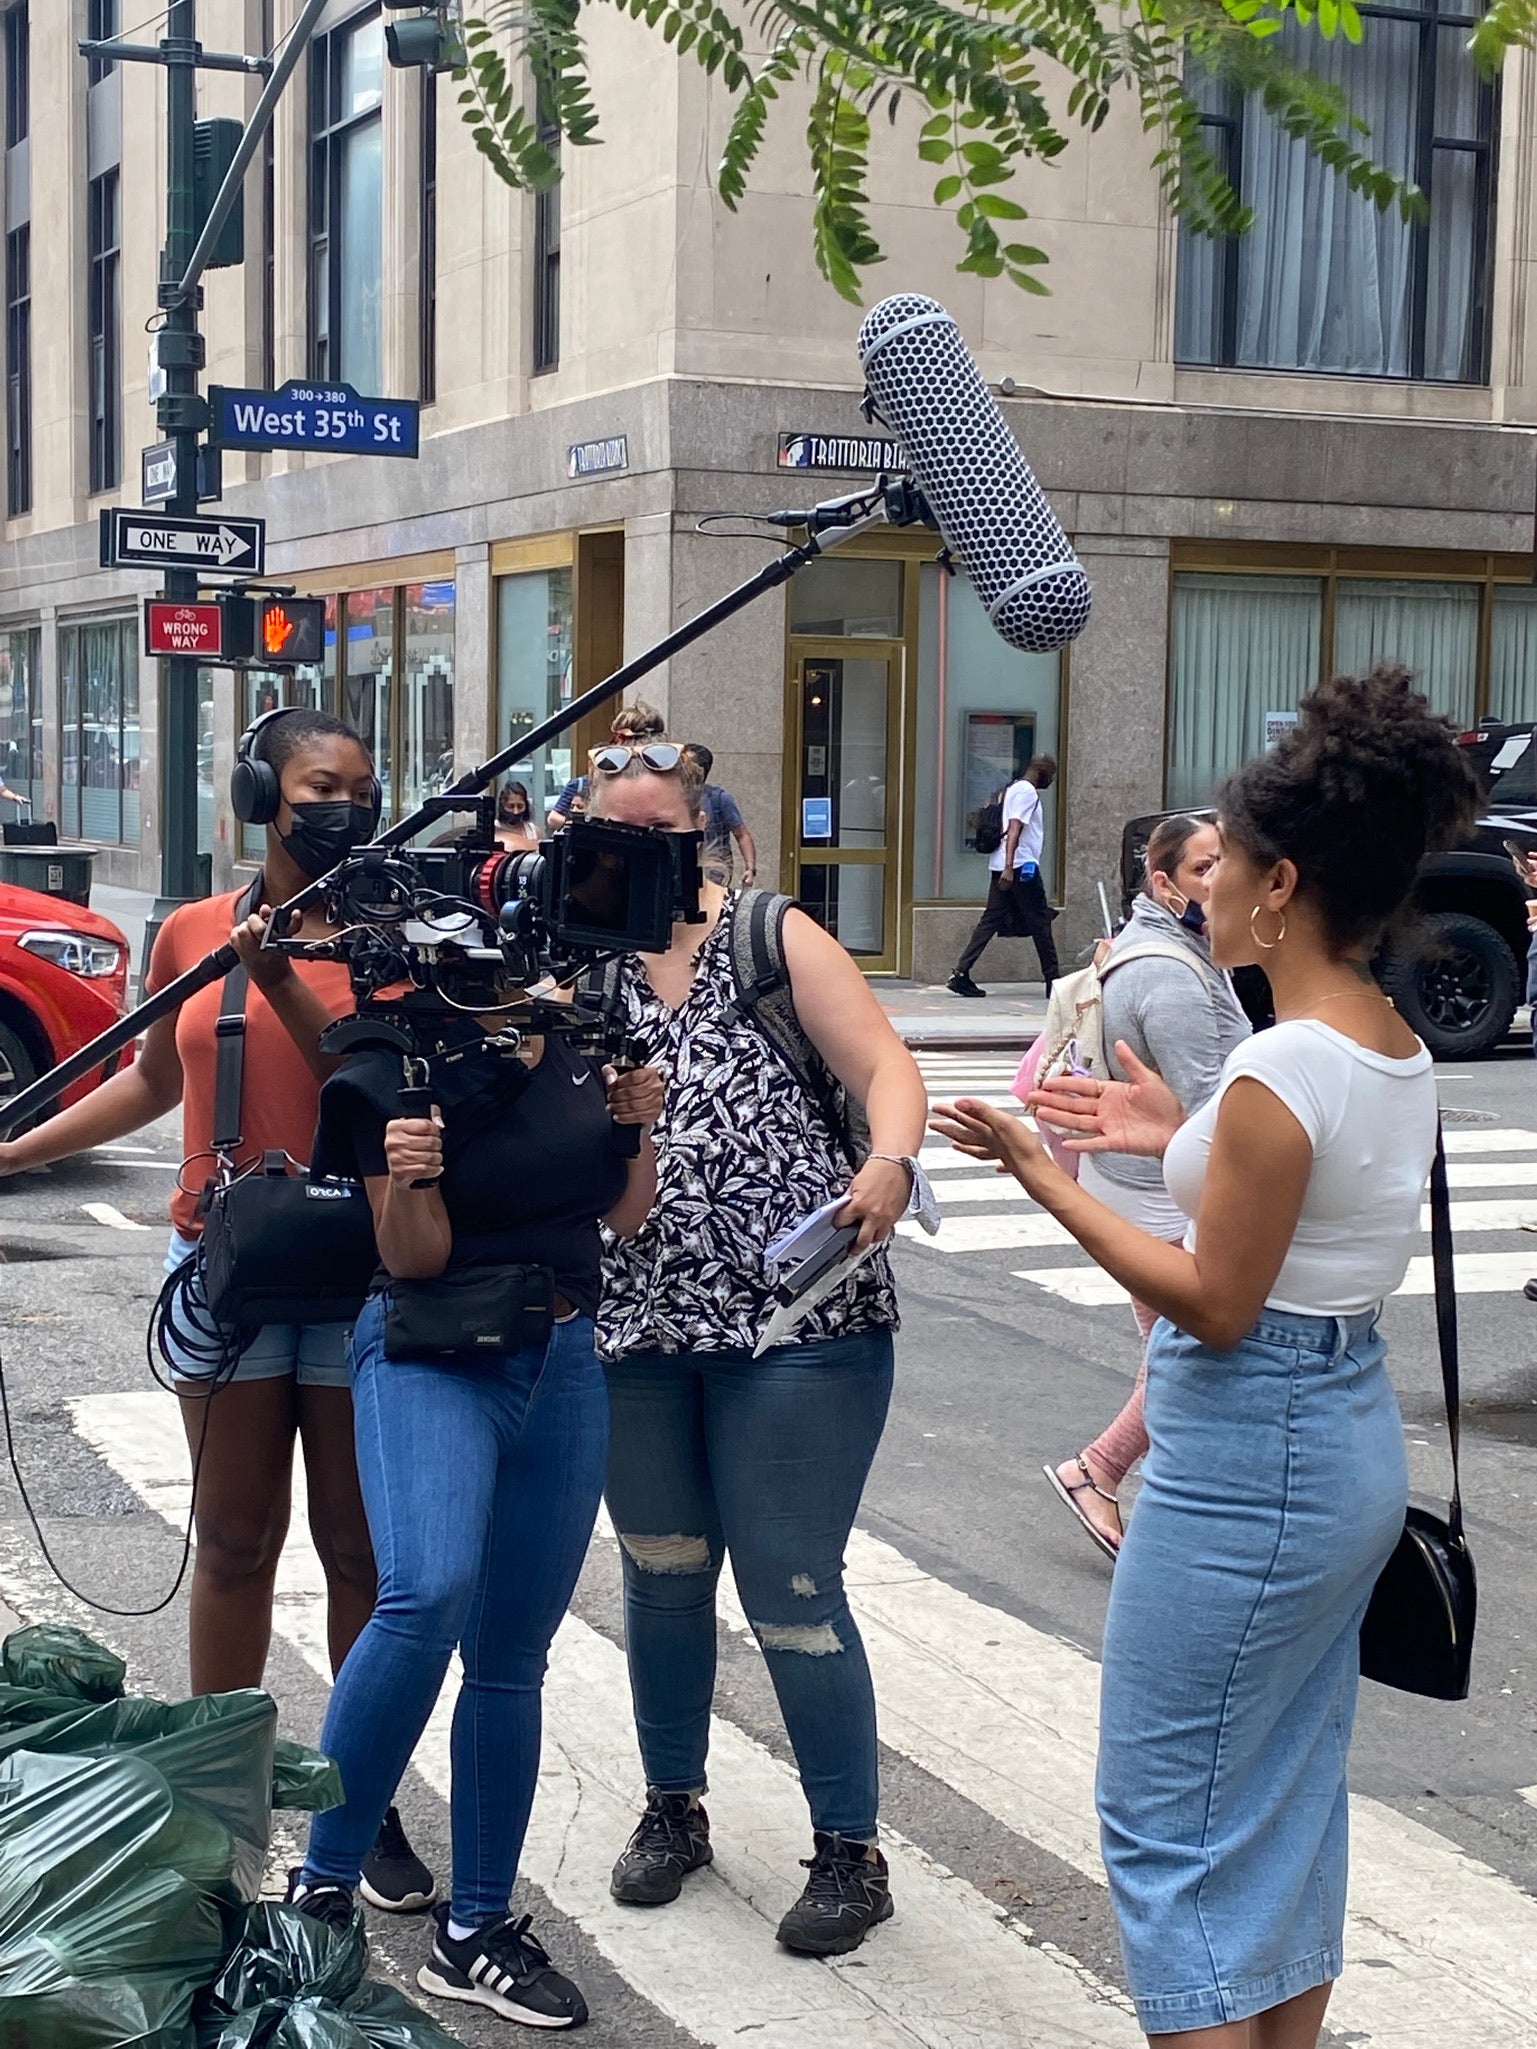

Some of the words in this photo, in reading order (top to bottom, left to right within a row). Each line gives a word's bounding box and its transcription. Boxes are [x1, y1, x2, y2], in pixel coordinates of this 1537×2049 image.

[233, 404, 305, 436] West
[314, 409, 364, 438] 35th
[373, 413, 400, 442] St
[810, 438, 881, 469] TRATTORIA
[883, 442, 910, 470] BIA
[140, 531, 177, 550] ONE
[196, 535, 237, 554] WAY
[162, 621, 208, 636] WRONG
[171, 635, 199, 648] WAY
[310, 1187, 341, 1197] ORCA
